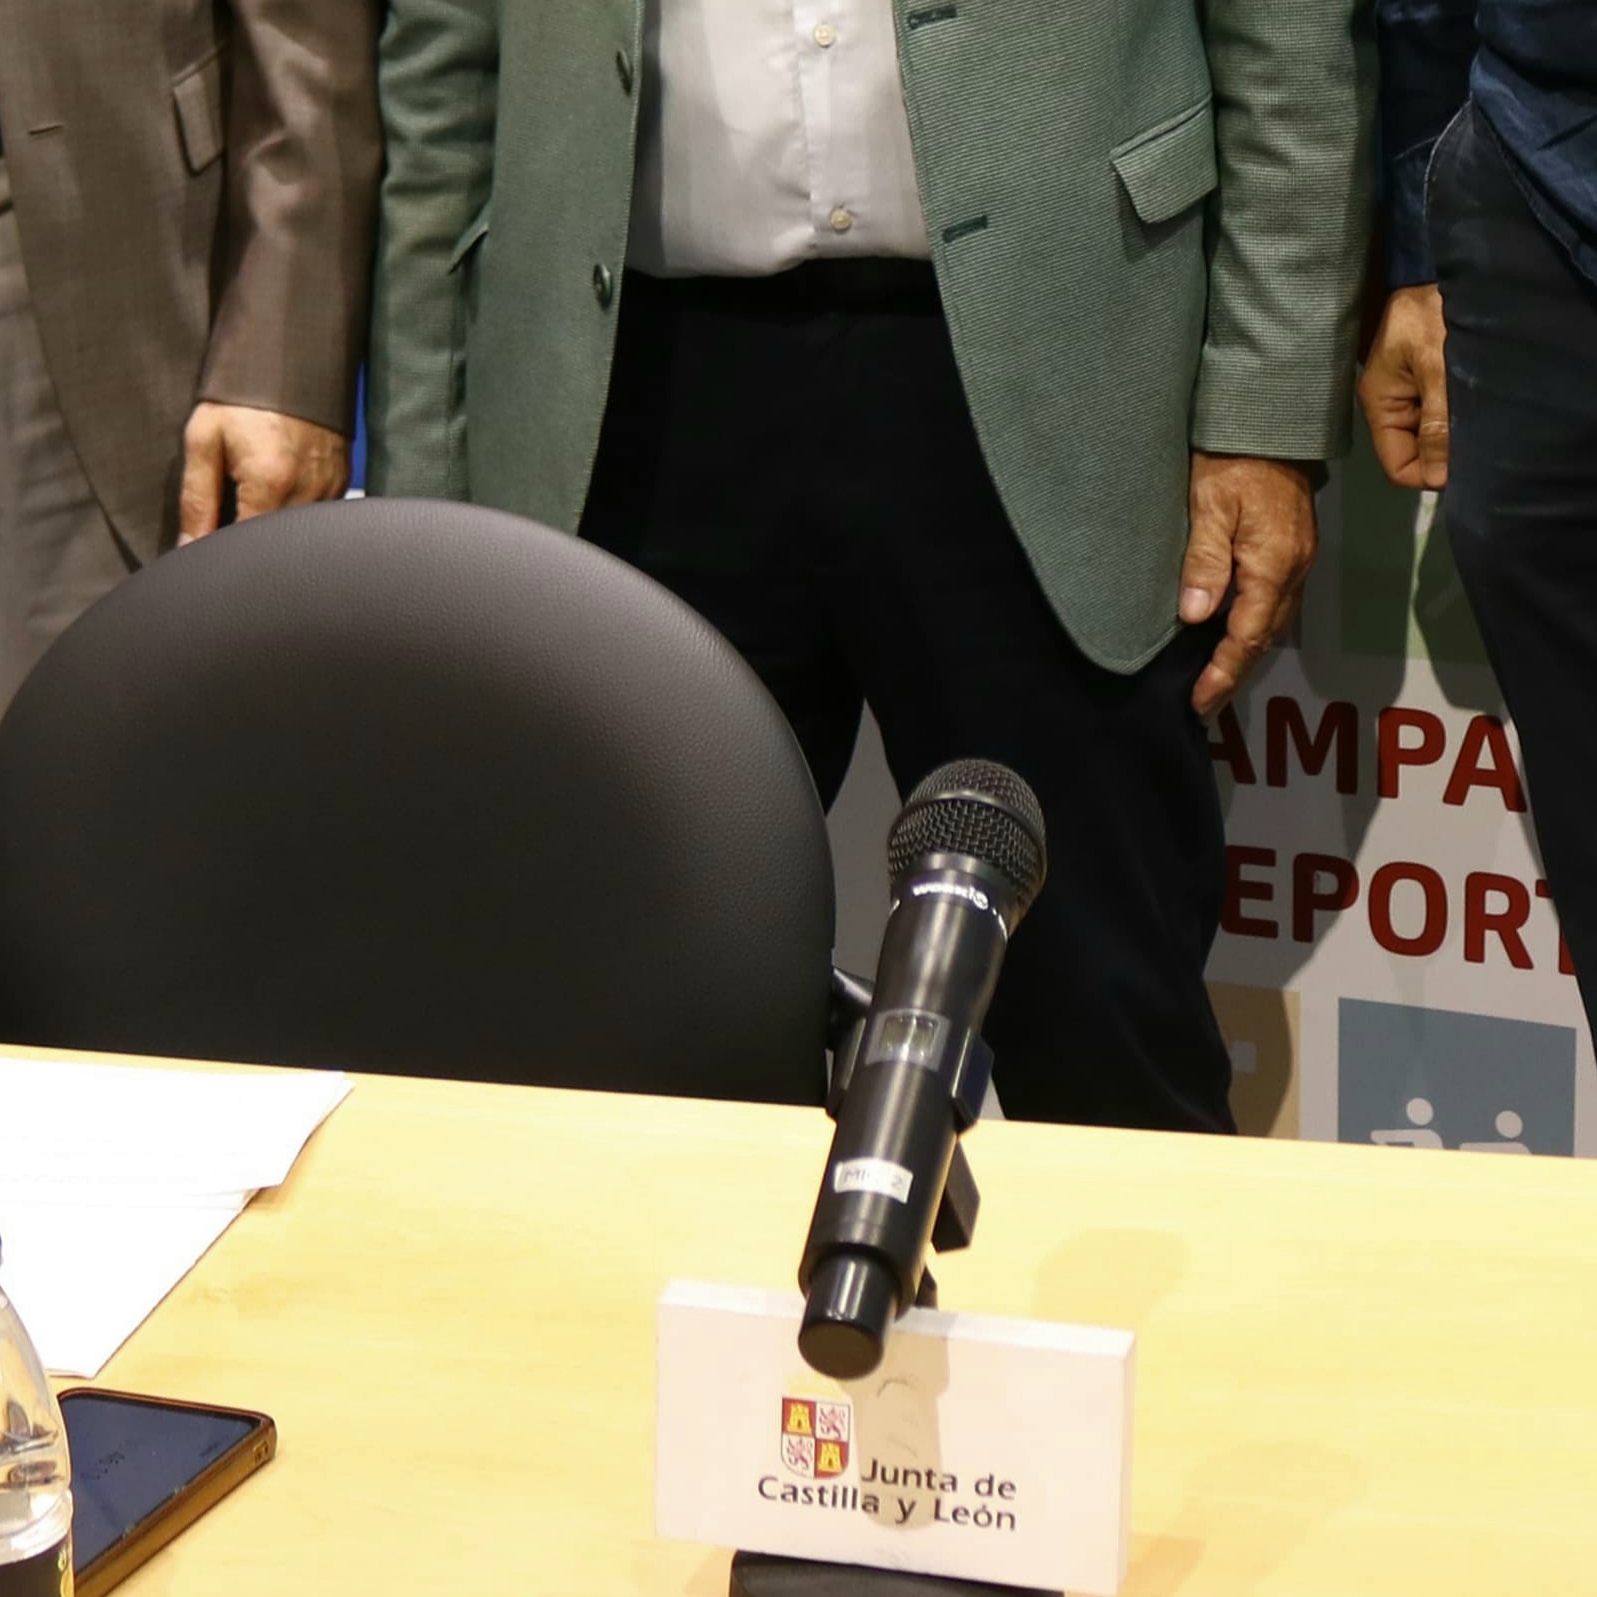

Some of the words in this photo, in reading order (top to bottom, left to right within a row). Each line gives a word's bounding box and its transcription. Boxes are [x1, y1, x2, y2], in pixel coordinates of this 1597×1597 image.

[1209, 695, 1528, 813] AMPA
[757, 1475, 880, 1516] Castilla
[895, 1498, 917, 1525] y
[933, 1502, 1017, 1533] León
[860, 1458, 958, 1495] Junta
[973, 1472, 1018, 1501] de
